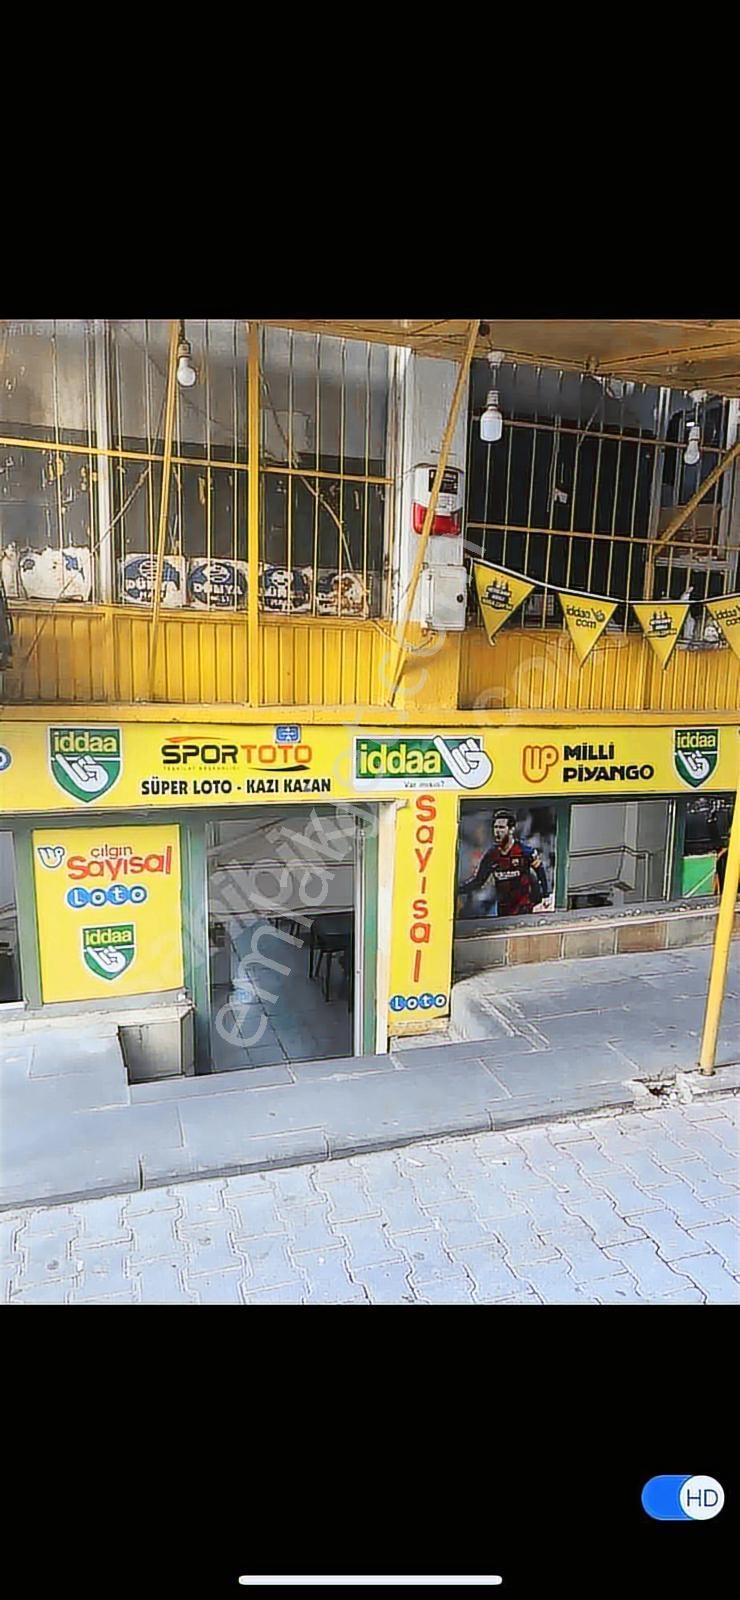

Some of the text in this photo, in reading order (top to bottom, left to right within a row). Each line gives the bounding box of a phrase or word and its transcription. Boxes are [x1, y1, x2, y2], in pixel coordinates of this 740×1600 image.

[54, 731, 117, 753] iddaa
[676, 732, 716, 749] iddaa
[360, 743, 441, 775] iddaa
[563, 742, 615, 760] MİLLİ
[563, 764, 654, 782] PİYANGO
[141, 776, 188, 795] SÜPER
[193, 780, 232, 794] LOTO
[246, 779, 279, 793] KAZI
[284, 778, 331, 793] KAZAN
[67, 846, 172, 881] Sayısal
[409, 794, 438, 983] Sayısal
[85, 928, 132, 946] iddaa
